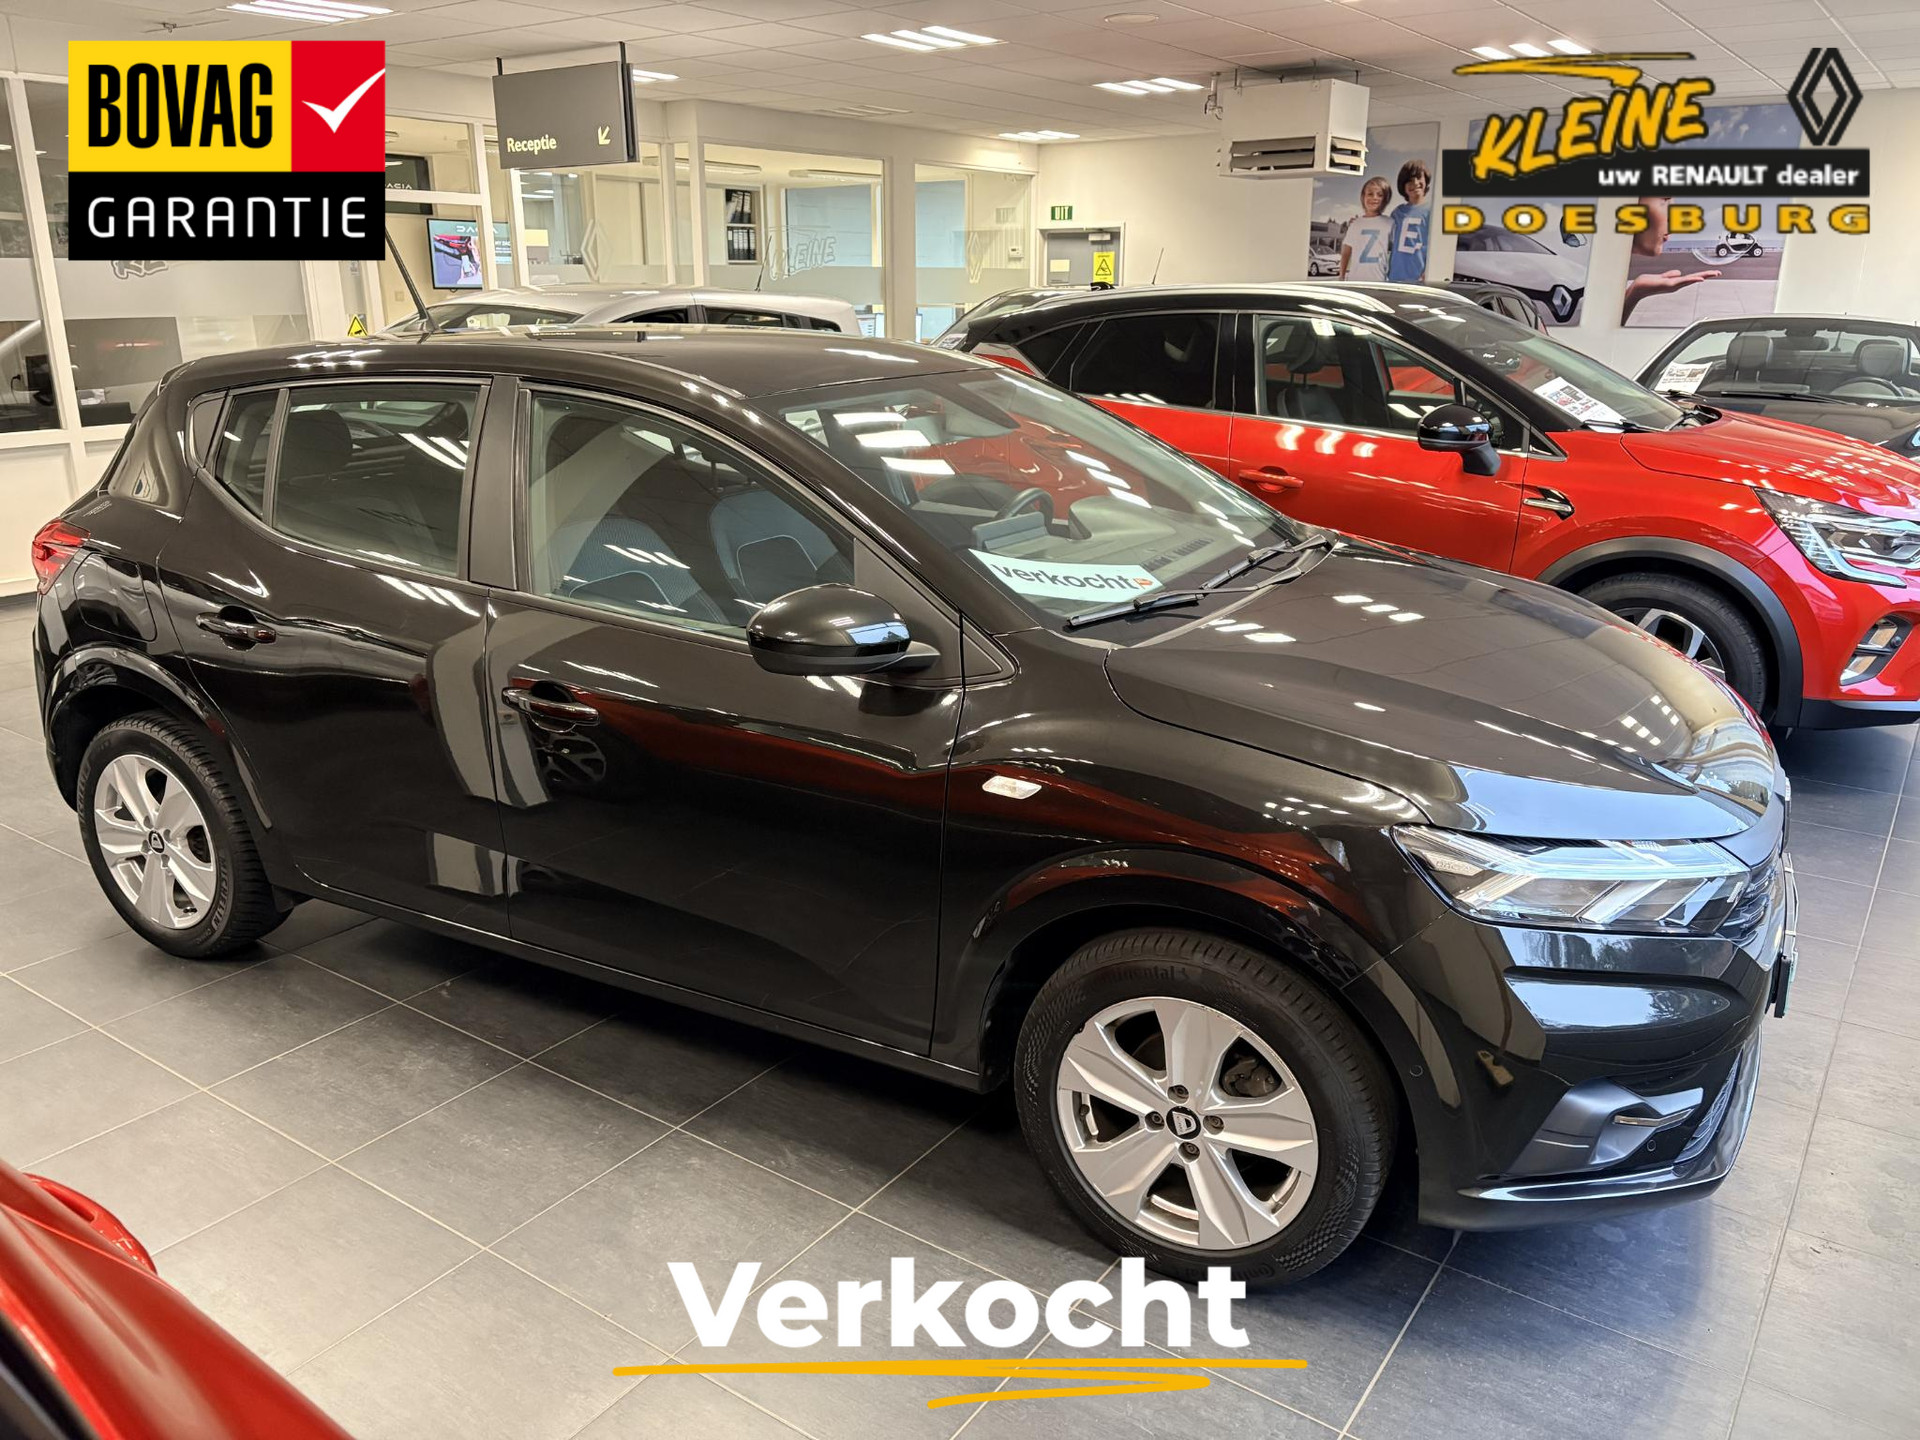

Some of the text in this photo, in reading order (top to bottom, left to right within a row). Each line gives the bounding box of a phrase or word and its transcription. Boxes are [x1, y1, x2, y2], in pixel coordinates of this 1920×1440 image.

[506, 134, 557, 155] Receptie
[1055, 206, 1069, 220] UIT
[991, 554, 1139, 590] verkocht
